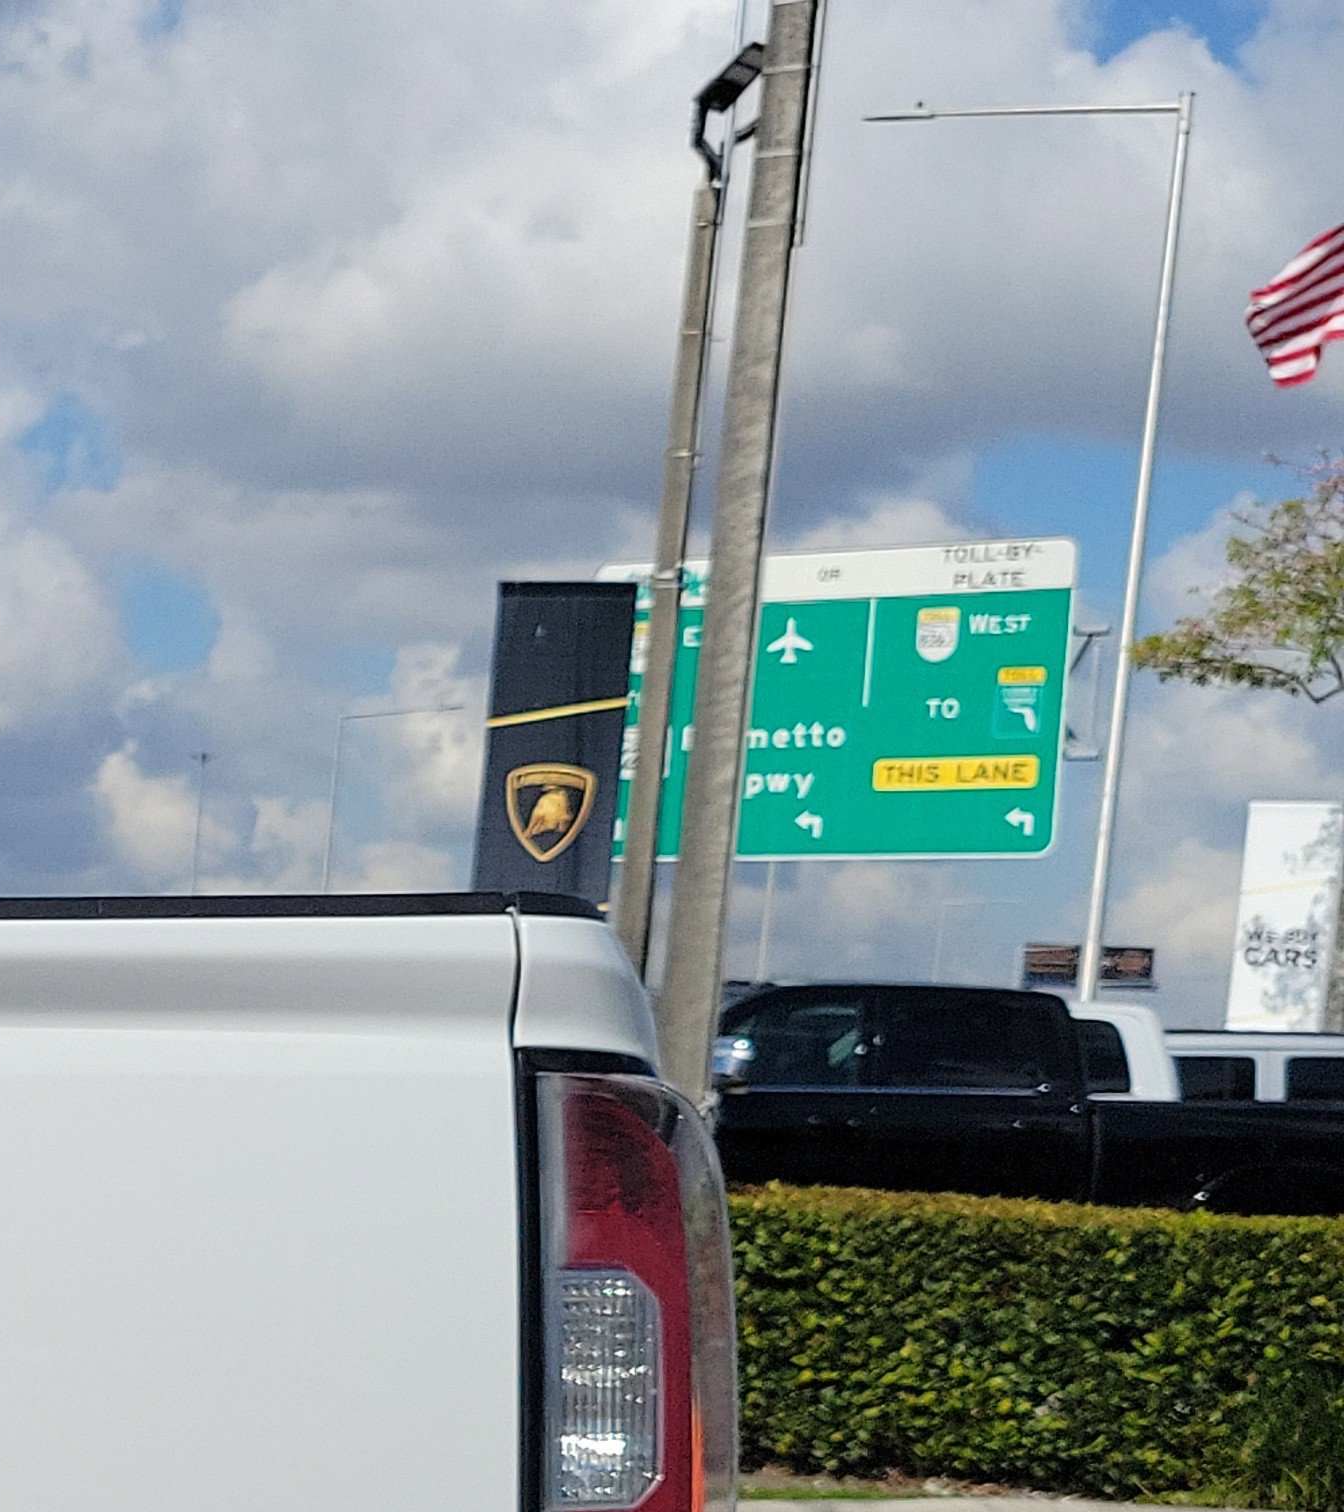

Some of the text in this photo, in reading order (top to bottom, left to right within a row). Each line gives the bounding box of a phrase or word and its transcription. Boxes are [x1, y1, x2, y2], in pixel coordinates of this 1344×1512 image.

[968, 613, 1032, 635] WEST
[925, 698, 961, 718] TO
[883, 760, 1029, 785] THIS LANE
[1244, 946, 1318, 969] CARS
